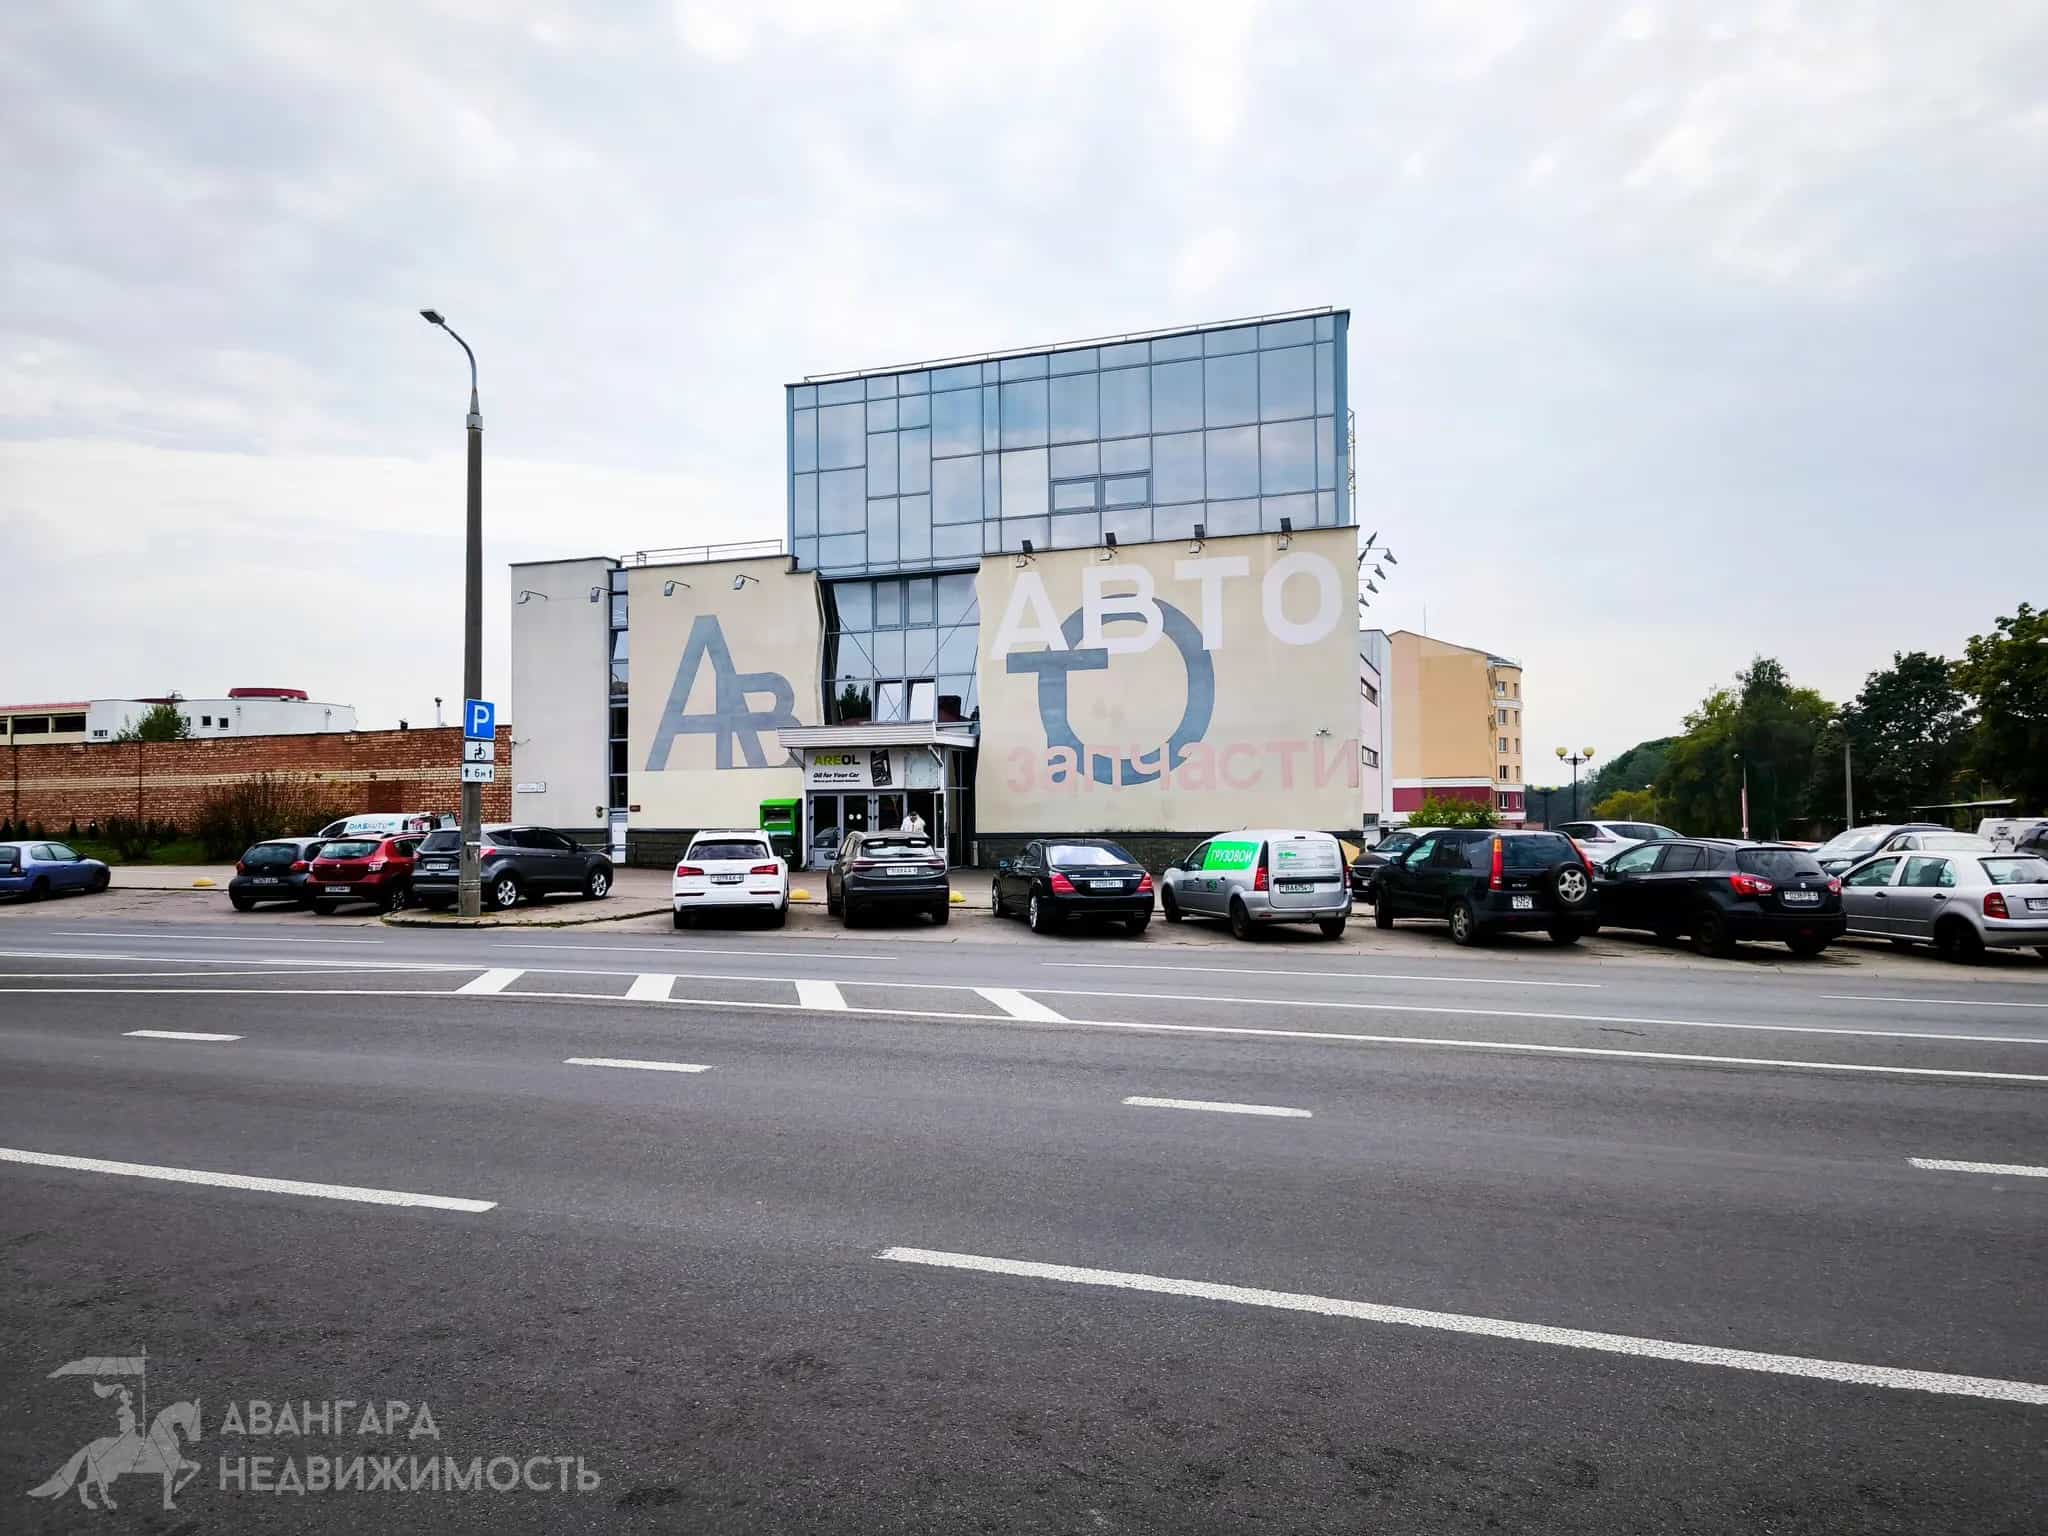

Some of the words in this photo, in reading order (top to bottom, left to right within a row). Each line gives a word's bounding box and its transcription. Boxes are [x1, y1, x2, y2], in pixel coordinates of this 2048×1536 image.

[991, 552, 1342, 661] АВТО
[473, 704, 490, 734] P
[813, 754, 861, 766] AREOL
[1007, 738, 1360, 794] запчасти
